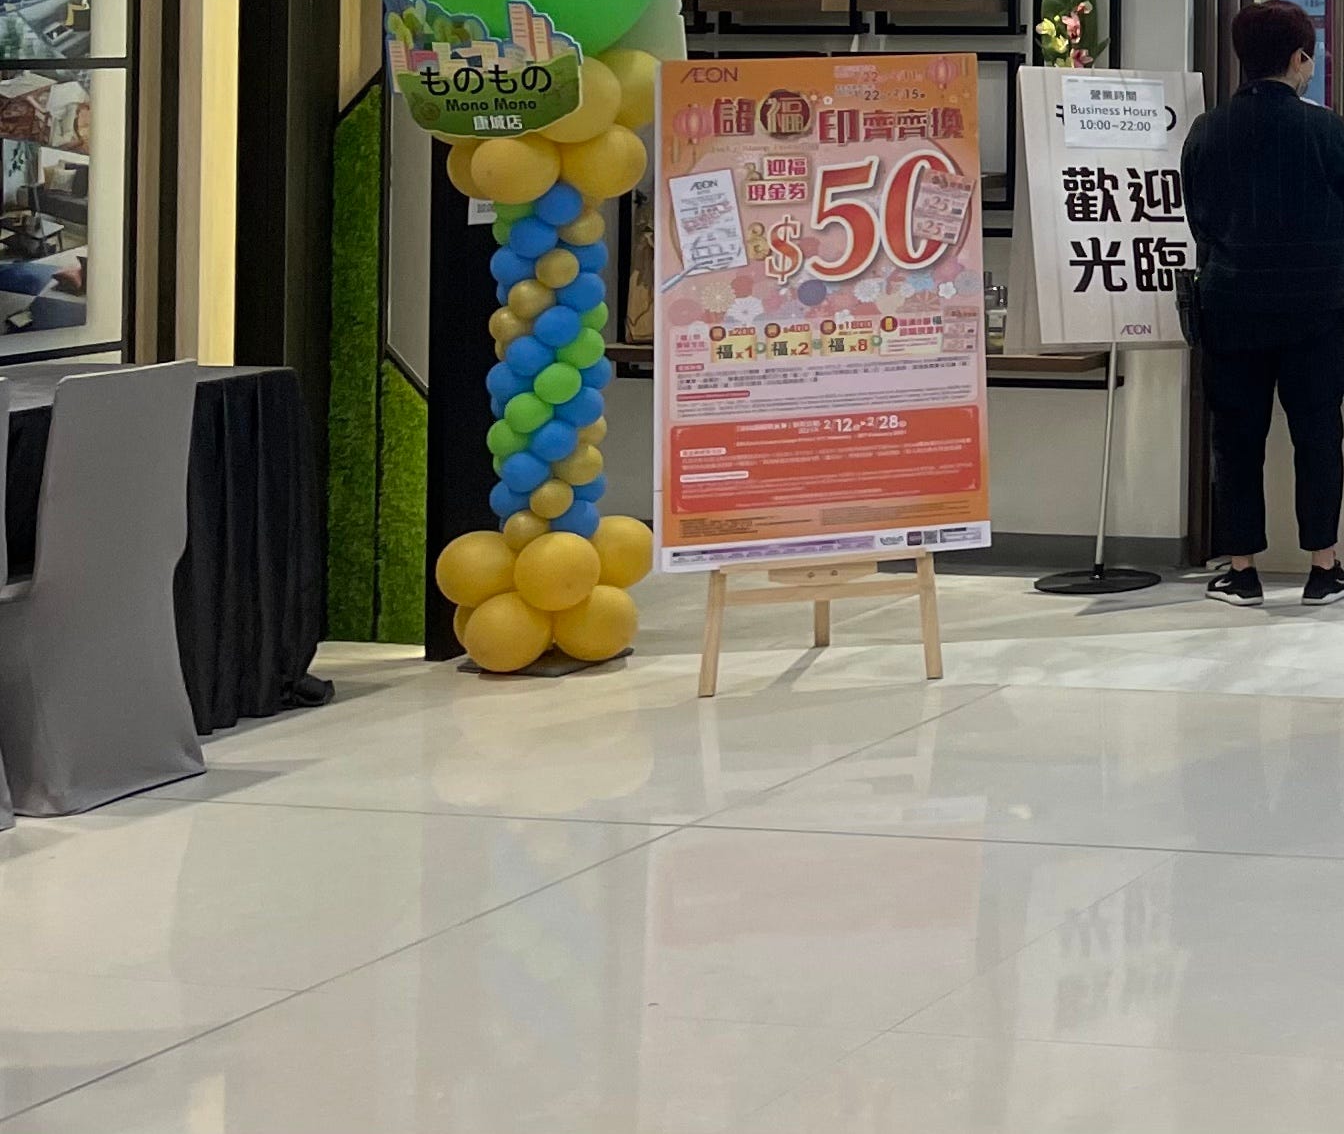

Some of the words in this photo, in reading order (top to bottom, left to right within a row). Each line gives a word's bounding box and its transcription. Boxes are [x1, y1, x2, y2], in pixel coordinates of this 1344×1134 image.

[420, 64, 552, 96] ものもの
[446, 99, 489, 112] Mono
[494, 97, 537, 111] Mono
[1090, 89, 1137, 102] 營業時間
[1070, 104, 1120, 116] Business
[1123, 105, 1158, 117] Hours
[767, 159, 806, 177] 迎福
[747, 183, 806, 201] 現金券
[1062, 167, 1185, 223] 歡迎
[1069, 237, 1187, 292] 光臨
